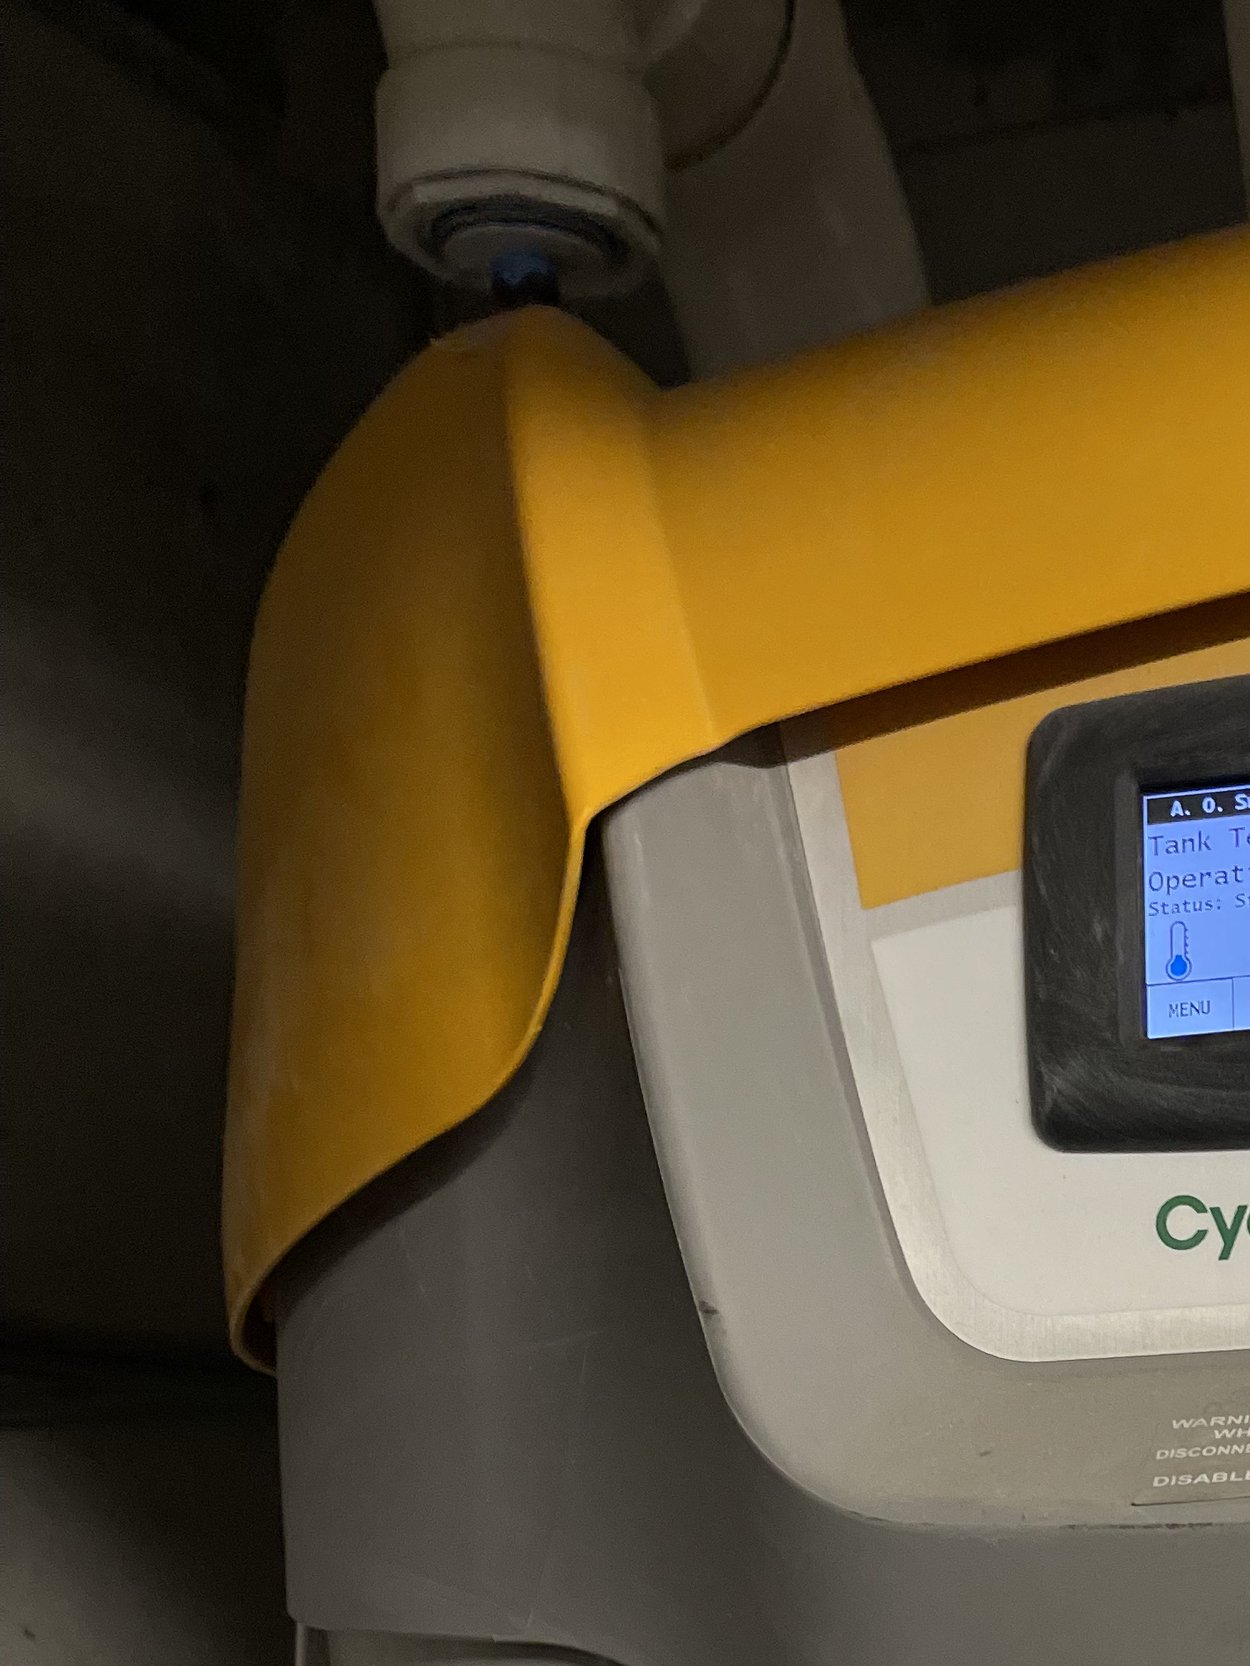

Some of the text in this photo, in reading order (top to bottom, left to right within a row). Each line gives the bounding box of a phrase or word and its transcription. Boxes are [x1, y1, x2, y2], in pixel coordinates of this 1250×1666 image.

[1170, 800, 1191, 817] A.
[1202, 798, 1223, 813] O.
[1150, 832, 1211, 856] Tank
[1149, 898, 1222, 916] Status:
[1168, 1001, 1210, 1019] MENU
